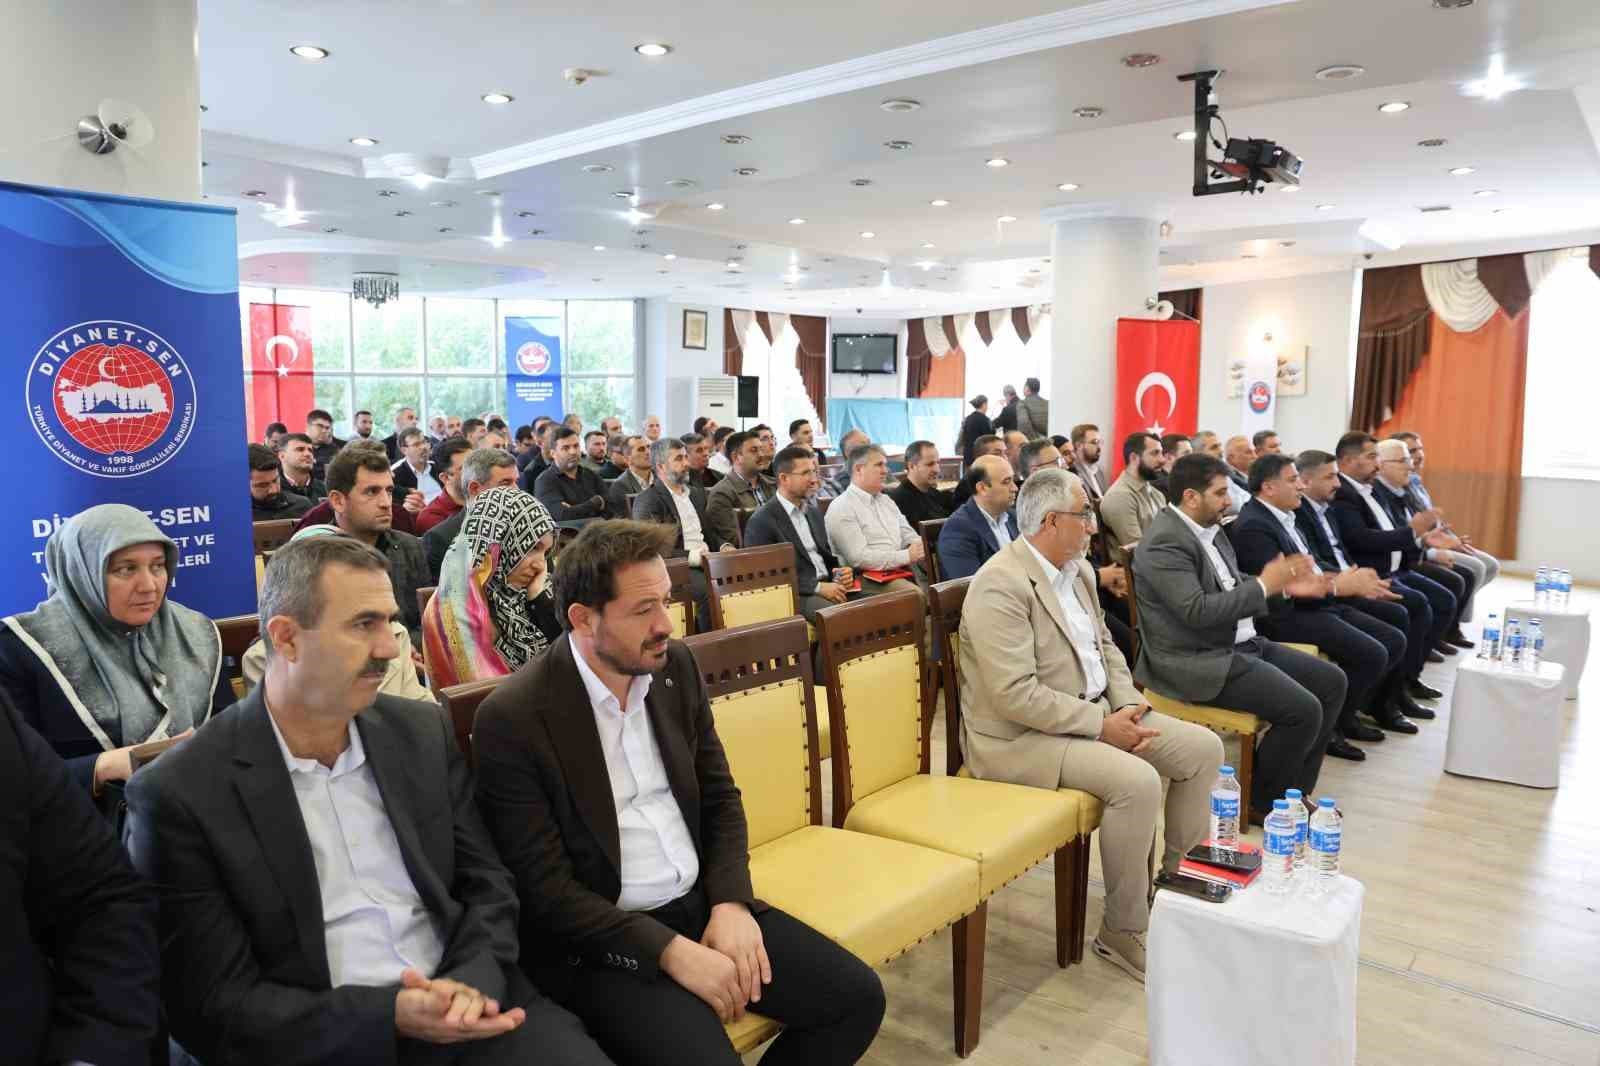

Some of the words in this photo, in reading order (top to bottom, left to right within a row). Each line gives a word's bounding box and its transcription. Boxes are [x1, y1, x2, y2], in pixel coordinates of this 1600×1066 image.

[38, 327, 184, 377] DİYANET-SEN
[33, 404, 55, 442] TÜRKİYE
[52, 440, 87, 467] DİYANET
[88, 463, 100, 472] VE
[106, 456, 134, 465] 1998
[193, 534, 215, 546] VE
